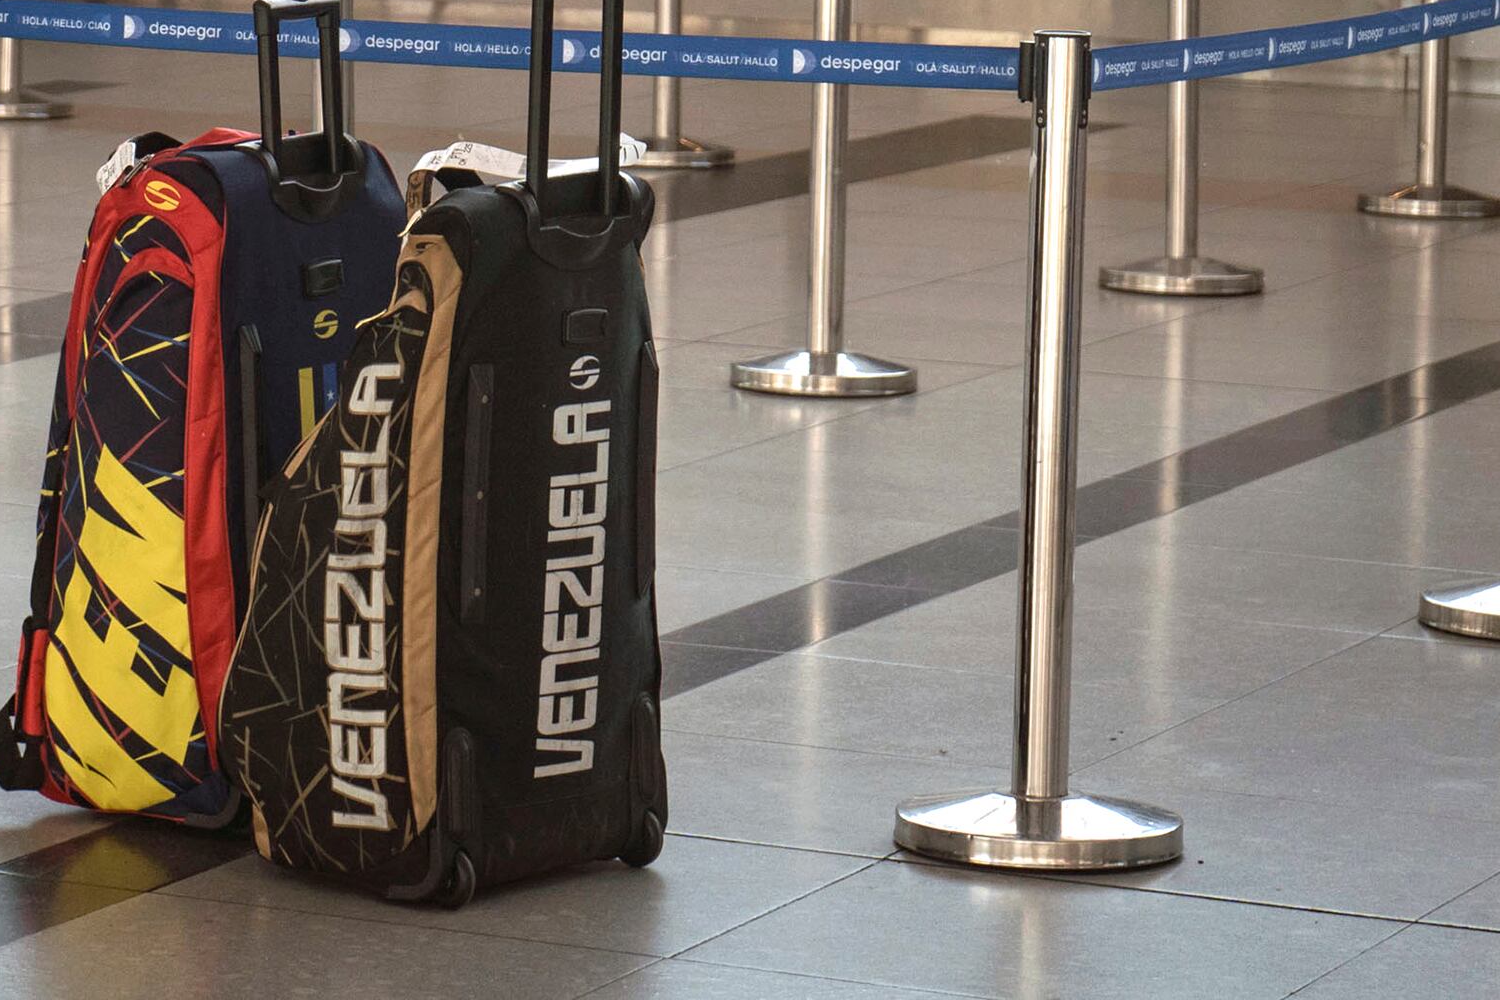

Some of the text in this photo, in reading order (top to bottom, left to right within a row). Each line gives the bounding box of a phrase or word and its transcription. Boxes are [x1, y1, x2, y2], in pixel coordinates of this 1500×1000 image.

[149, 21, 222, 41] despegar
[364, 34, 441, 54] despegar
[589, 44, 668, 64] dpegar
[820, 54, 902, 74] despegar
[1104, 60, 1138, 78] despegar
[1193, 49, 1226, 66] despegar
[1278, 38, 1308, 56] despegar
[323, 362, 403, 831] VENEZUELA
[533, 398, 612, 780] VENEZUELA
